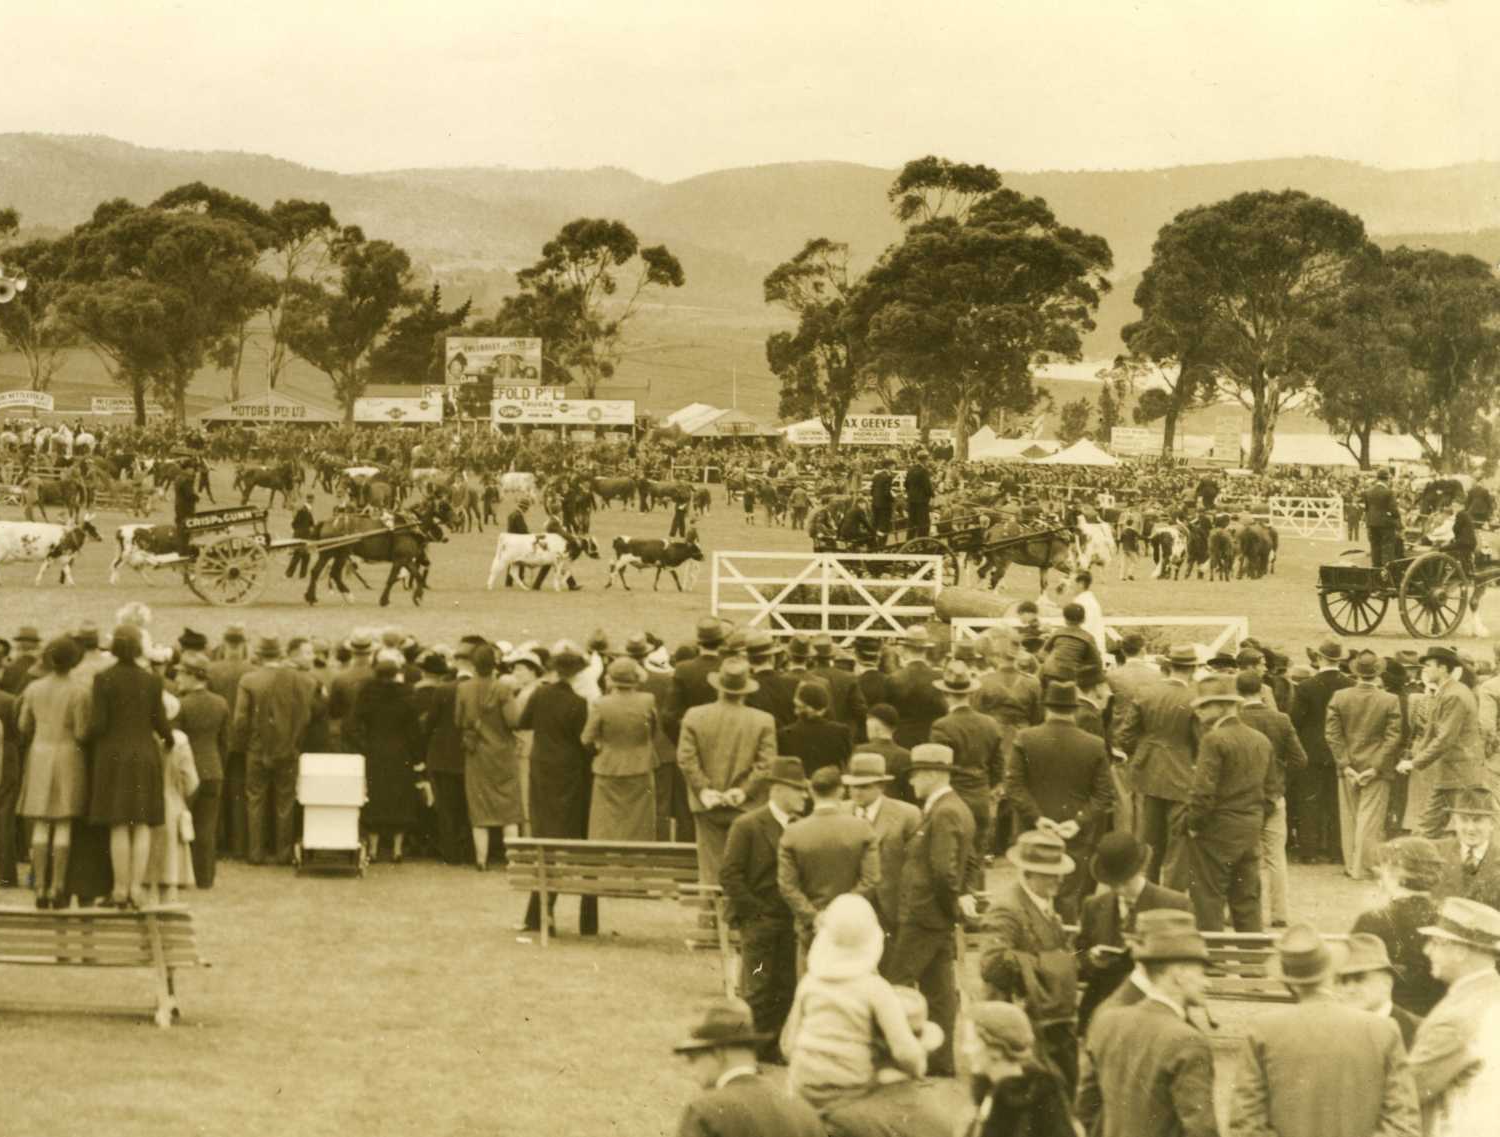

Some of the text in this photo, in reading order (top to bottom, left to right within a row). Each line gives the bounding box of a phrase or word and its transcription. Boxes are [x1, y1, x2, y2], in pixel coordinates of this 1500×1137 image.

[231, 405, 270, 417] MOTORS
[842, 418, 901, 430] AX GEEVES
